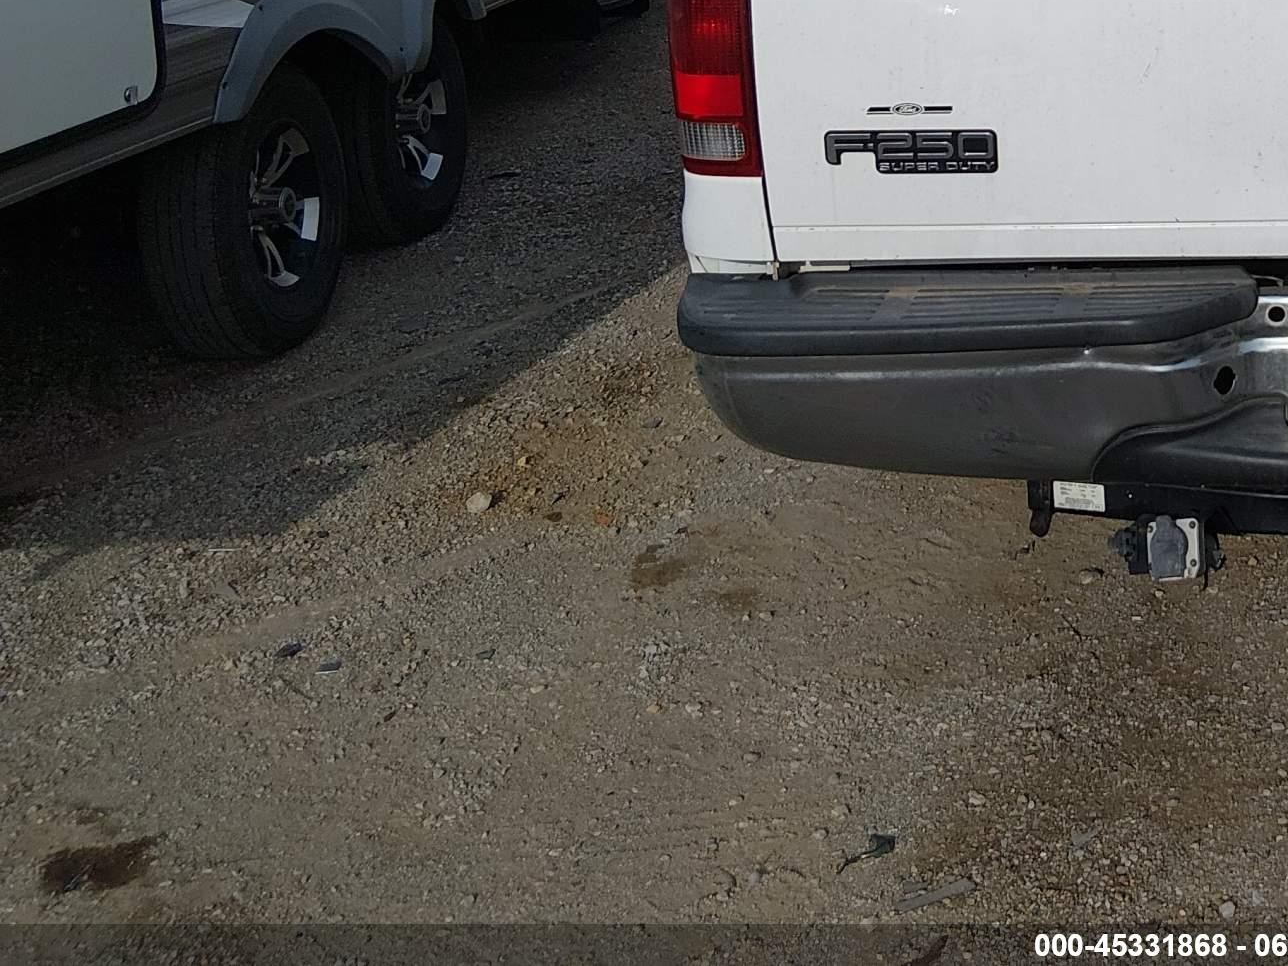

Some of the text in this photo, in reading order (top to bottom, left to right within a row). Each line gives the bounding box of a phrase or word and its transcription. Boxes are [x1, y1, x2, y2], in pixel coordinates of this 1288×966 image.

[825, 132, 996, 165] F-250
[879, 161, 996, 172] SUPER DUTY
